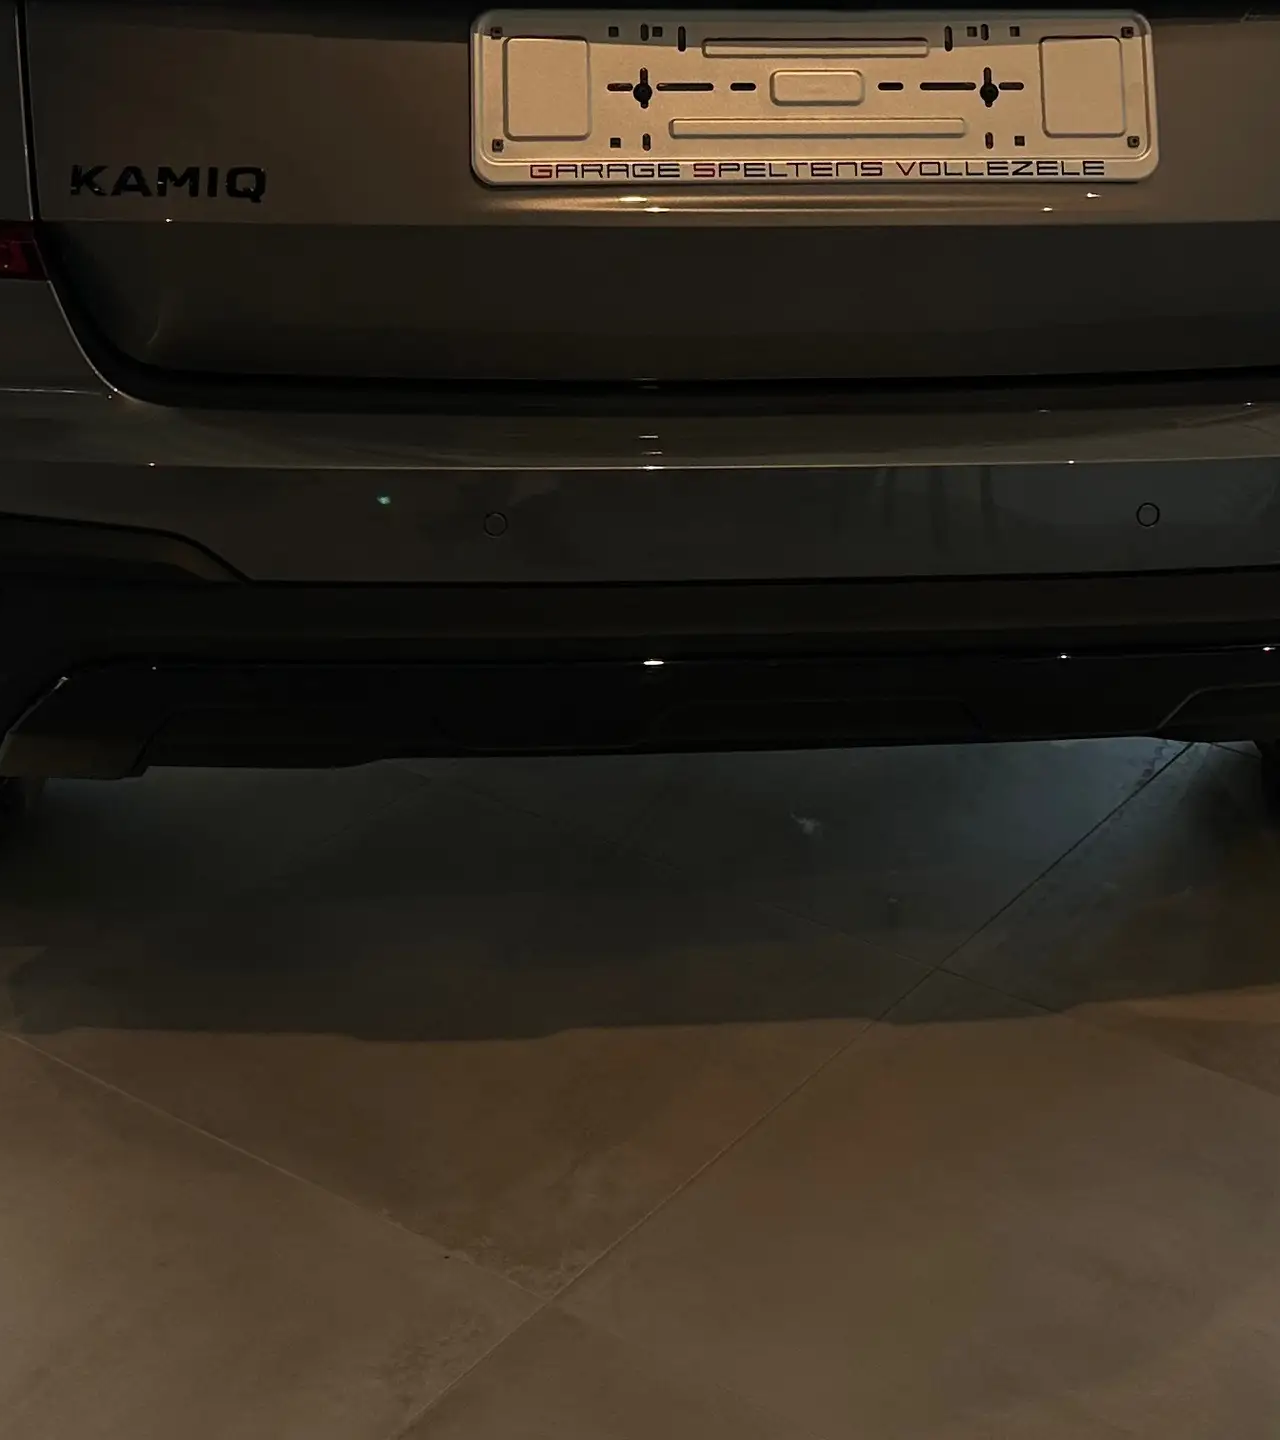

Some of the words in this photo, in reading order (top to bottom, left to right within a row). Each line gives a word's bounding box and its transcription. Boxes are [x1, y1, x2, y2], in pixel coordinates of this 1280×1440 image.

[70, 164, 267, 203] KAMIQ
[529, 162, 680, 179] GARAGE
[693, 161, 883, 178] SPELTENS
[895, 160, 1105, 177] VOLLEZELE
